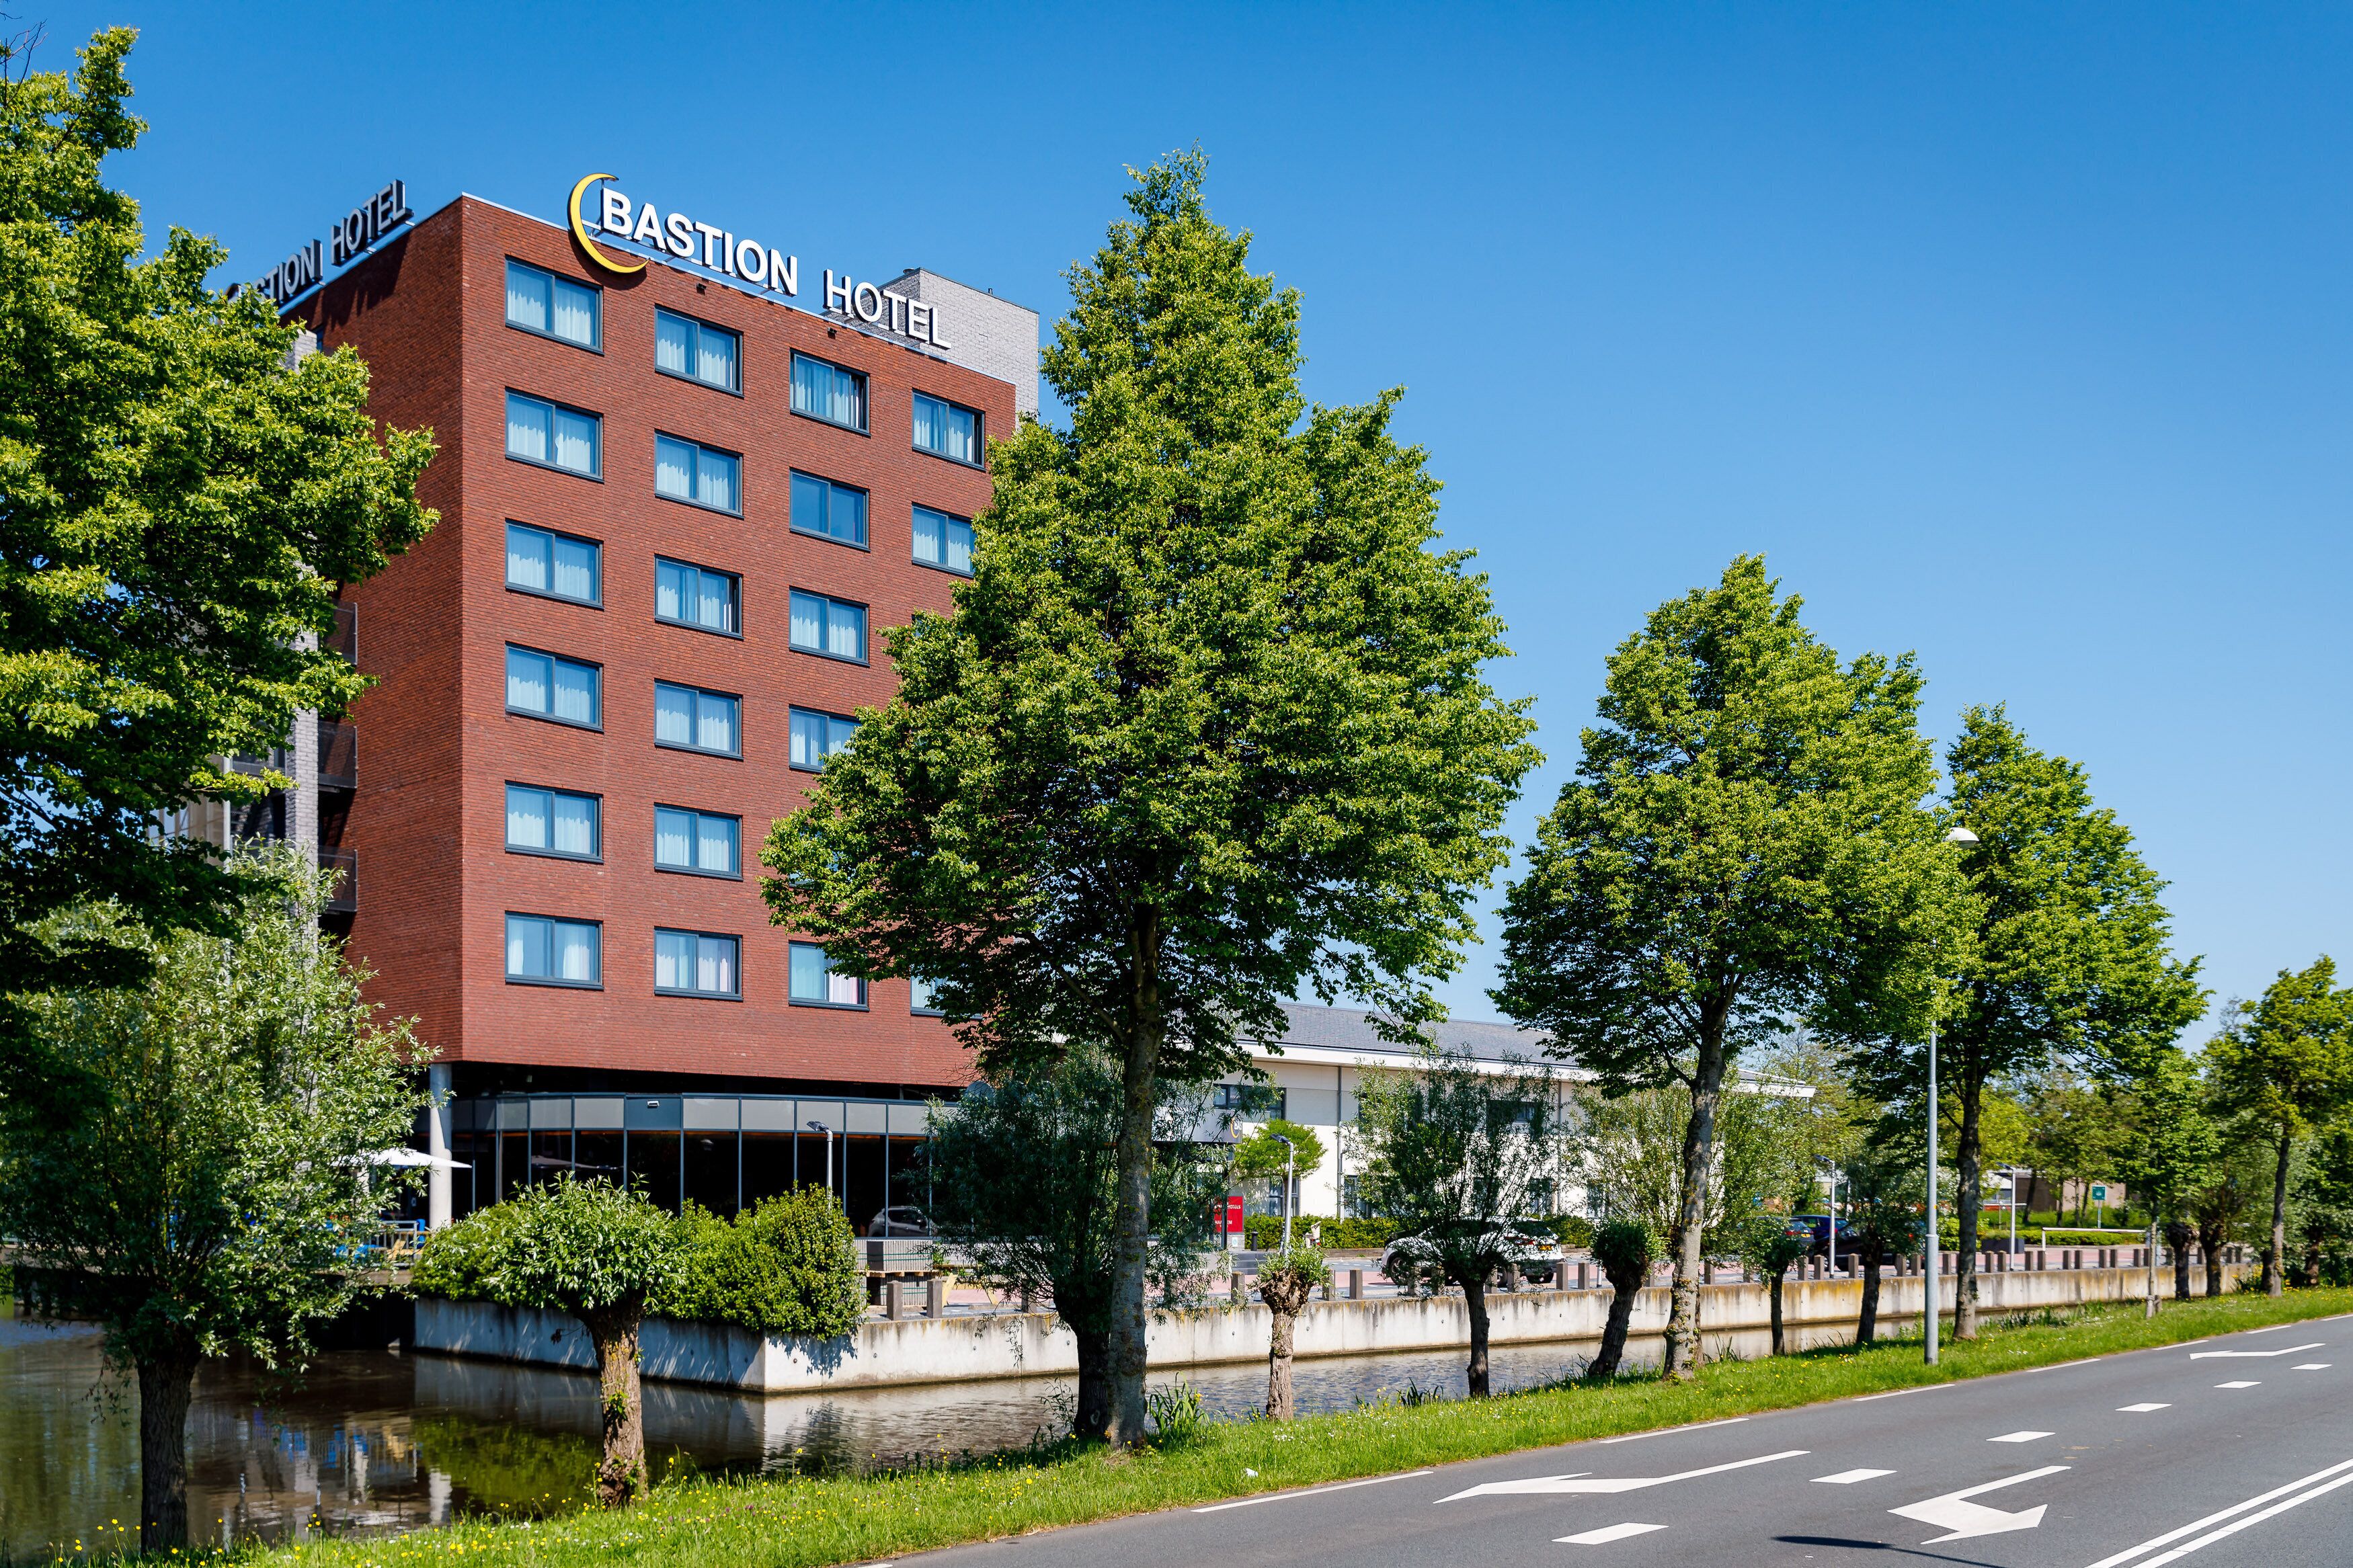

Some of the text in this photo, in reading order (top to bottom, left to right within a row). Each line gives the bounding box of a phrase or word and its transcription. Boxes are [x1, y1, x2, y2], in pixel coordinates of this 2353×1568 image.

[252, 179, 413, 304] STION HOTEL
[600, 187, 952, 350] BASTION HOTEL
